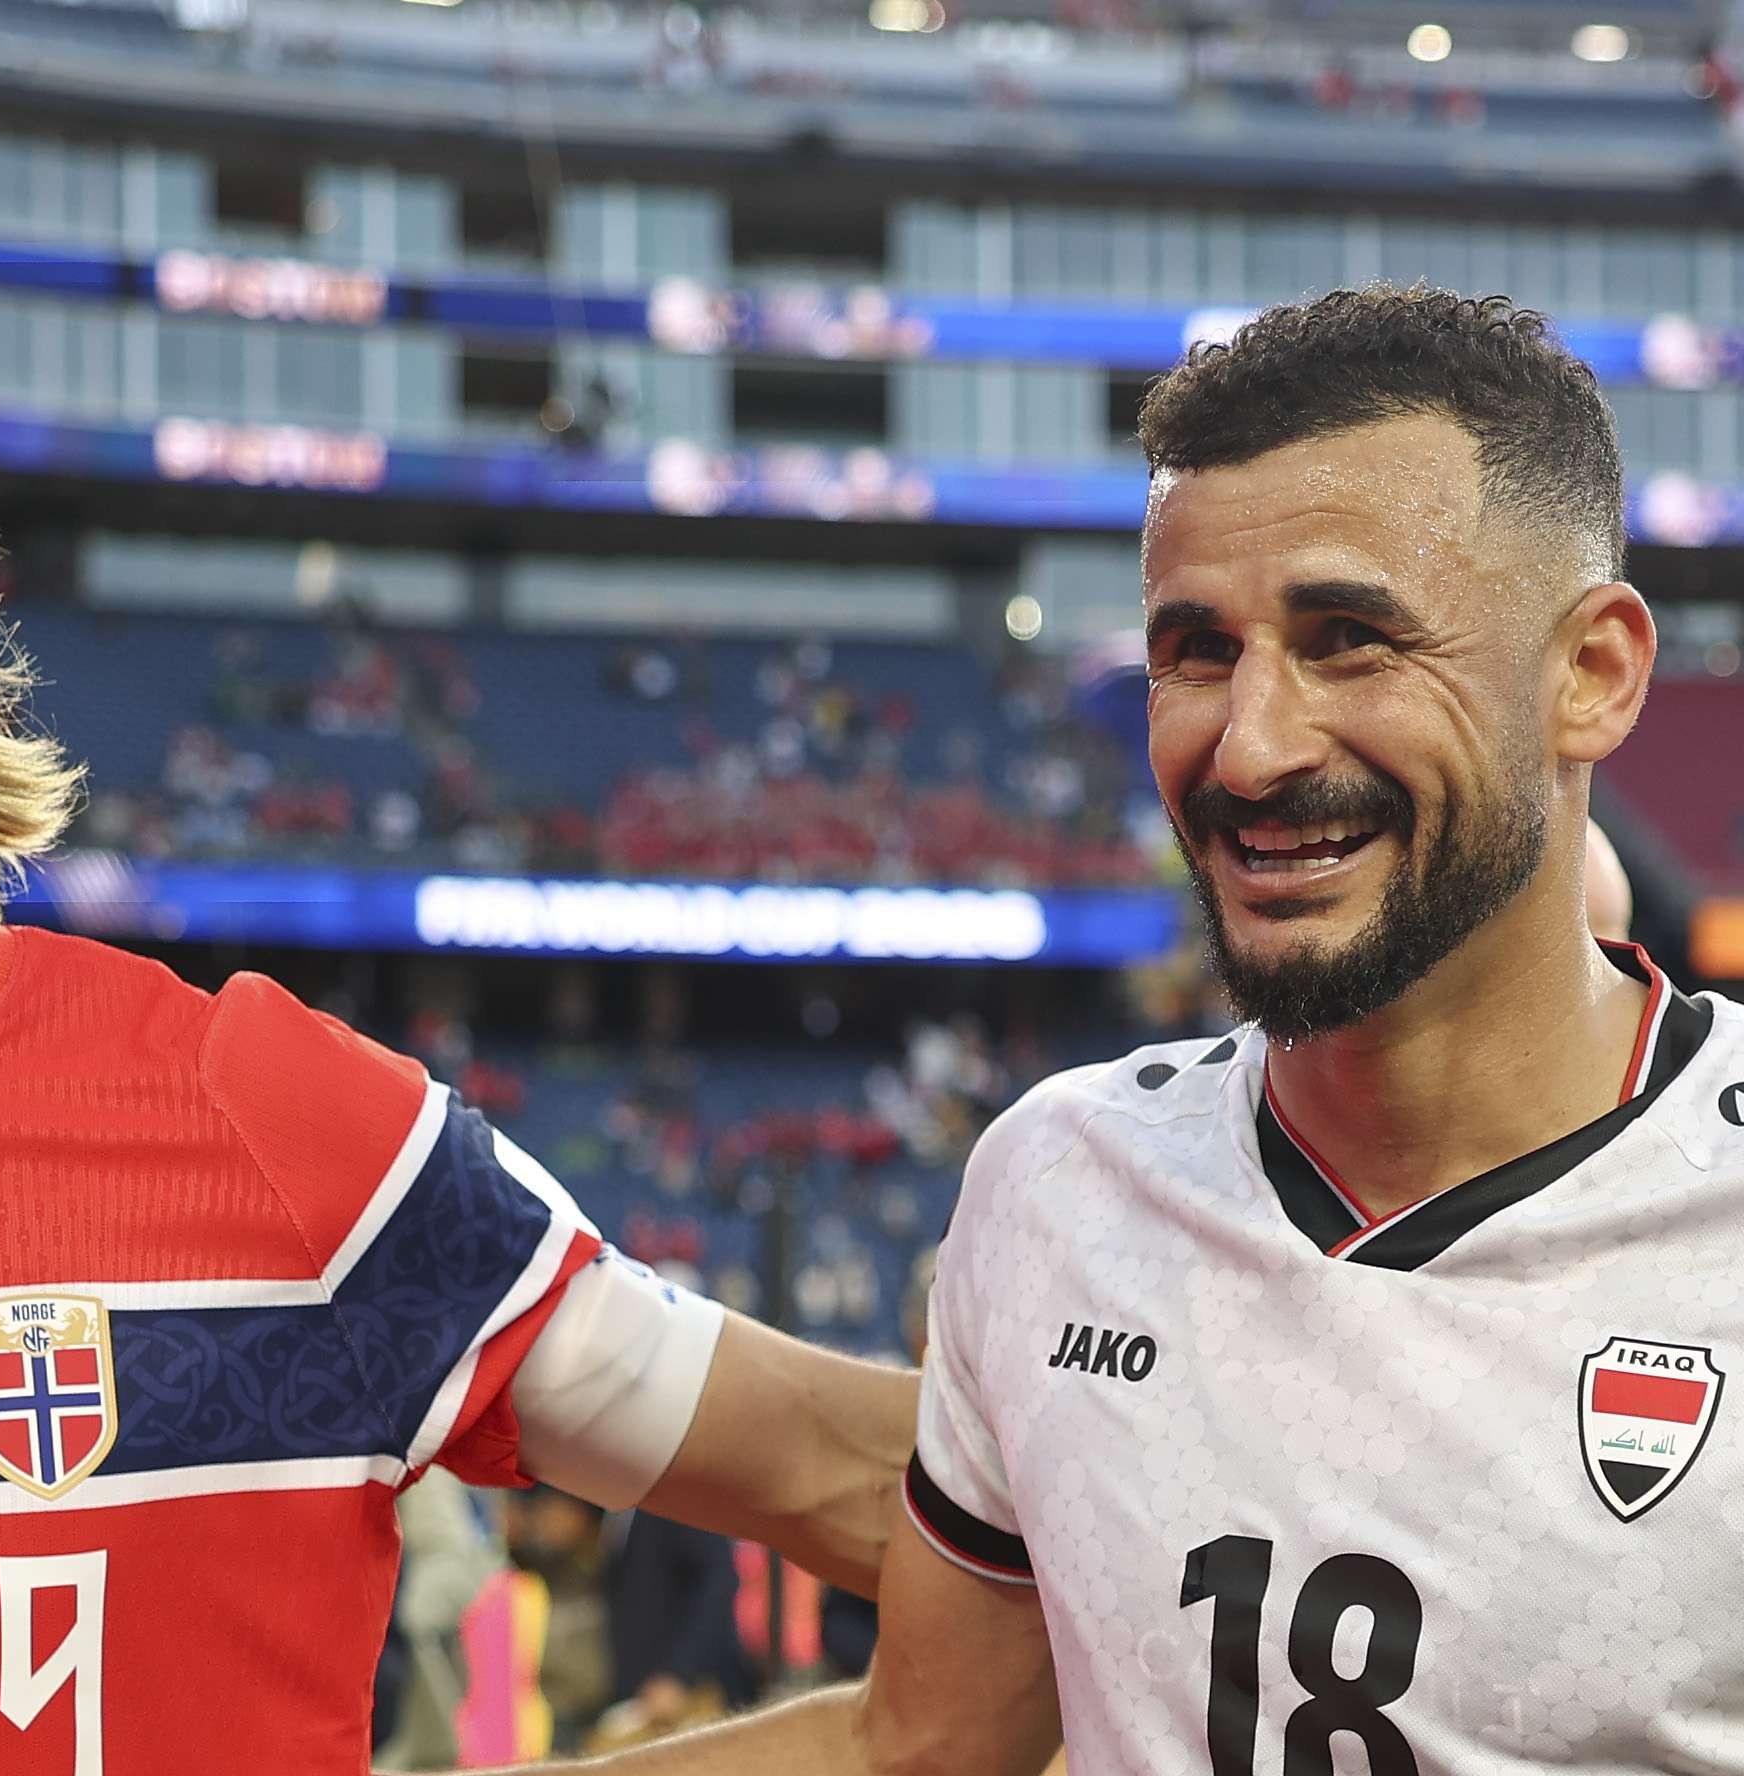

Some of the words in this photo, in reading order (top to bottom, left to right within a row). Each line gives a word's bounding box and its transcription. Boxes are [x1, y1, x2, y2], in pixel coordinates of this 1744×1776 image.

[12, 1303, 56, 1322] NORGE
[1048, 1323, 1157, 1382] JAKO
[1617, 1348, 1695, 1373] IRAQ
